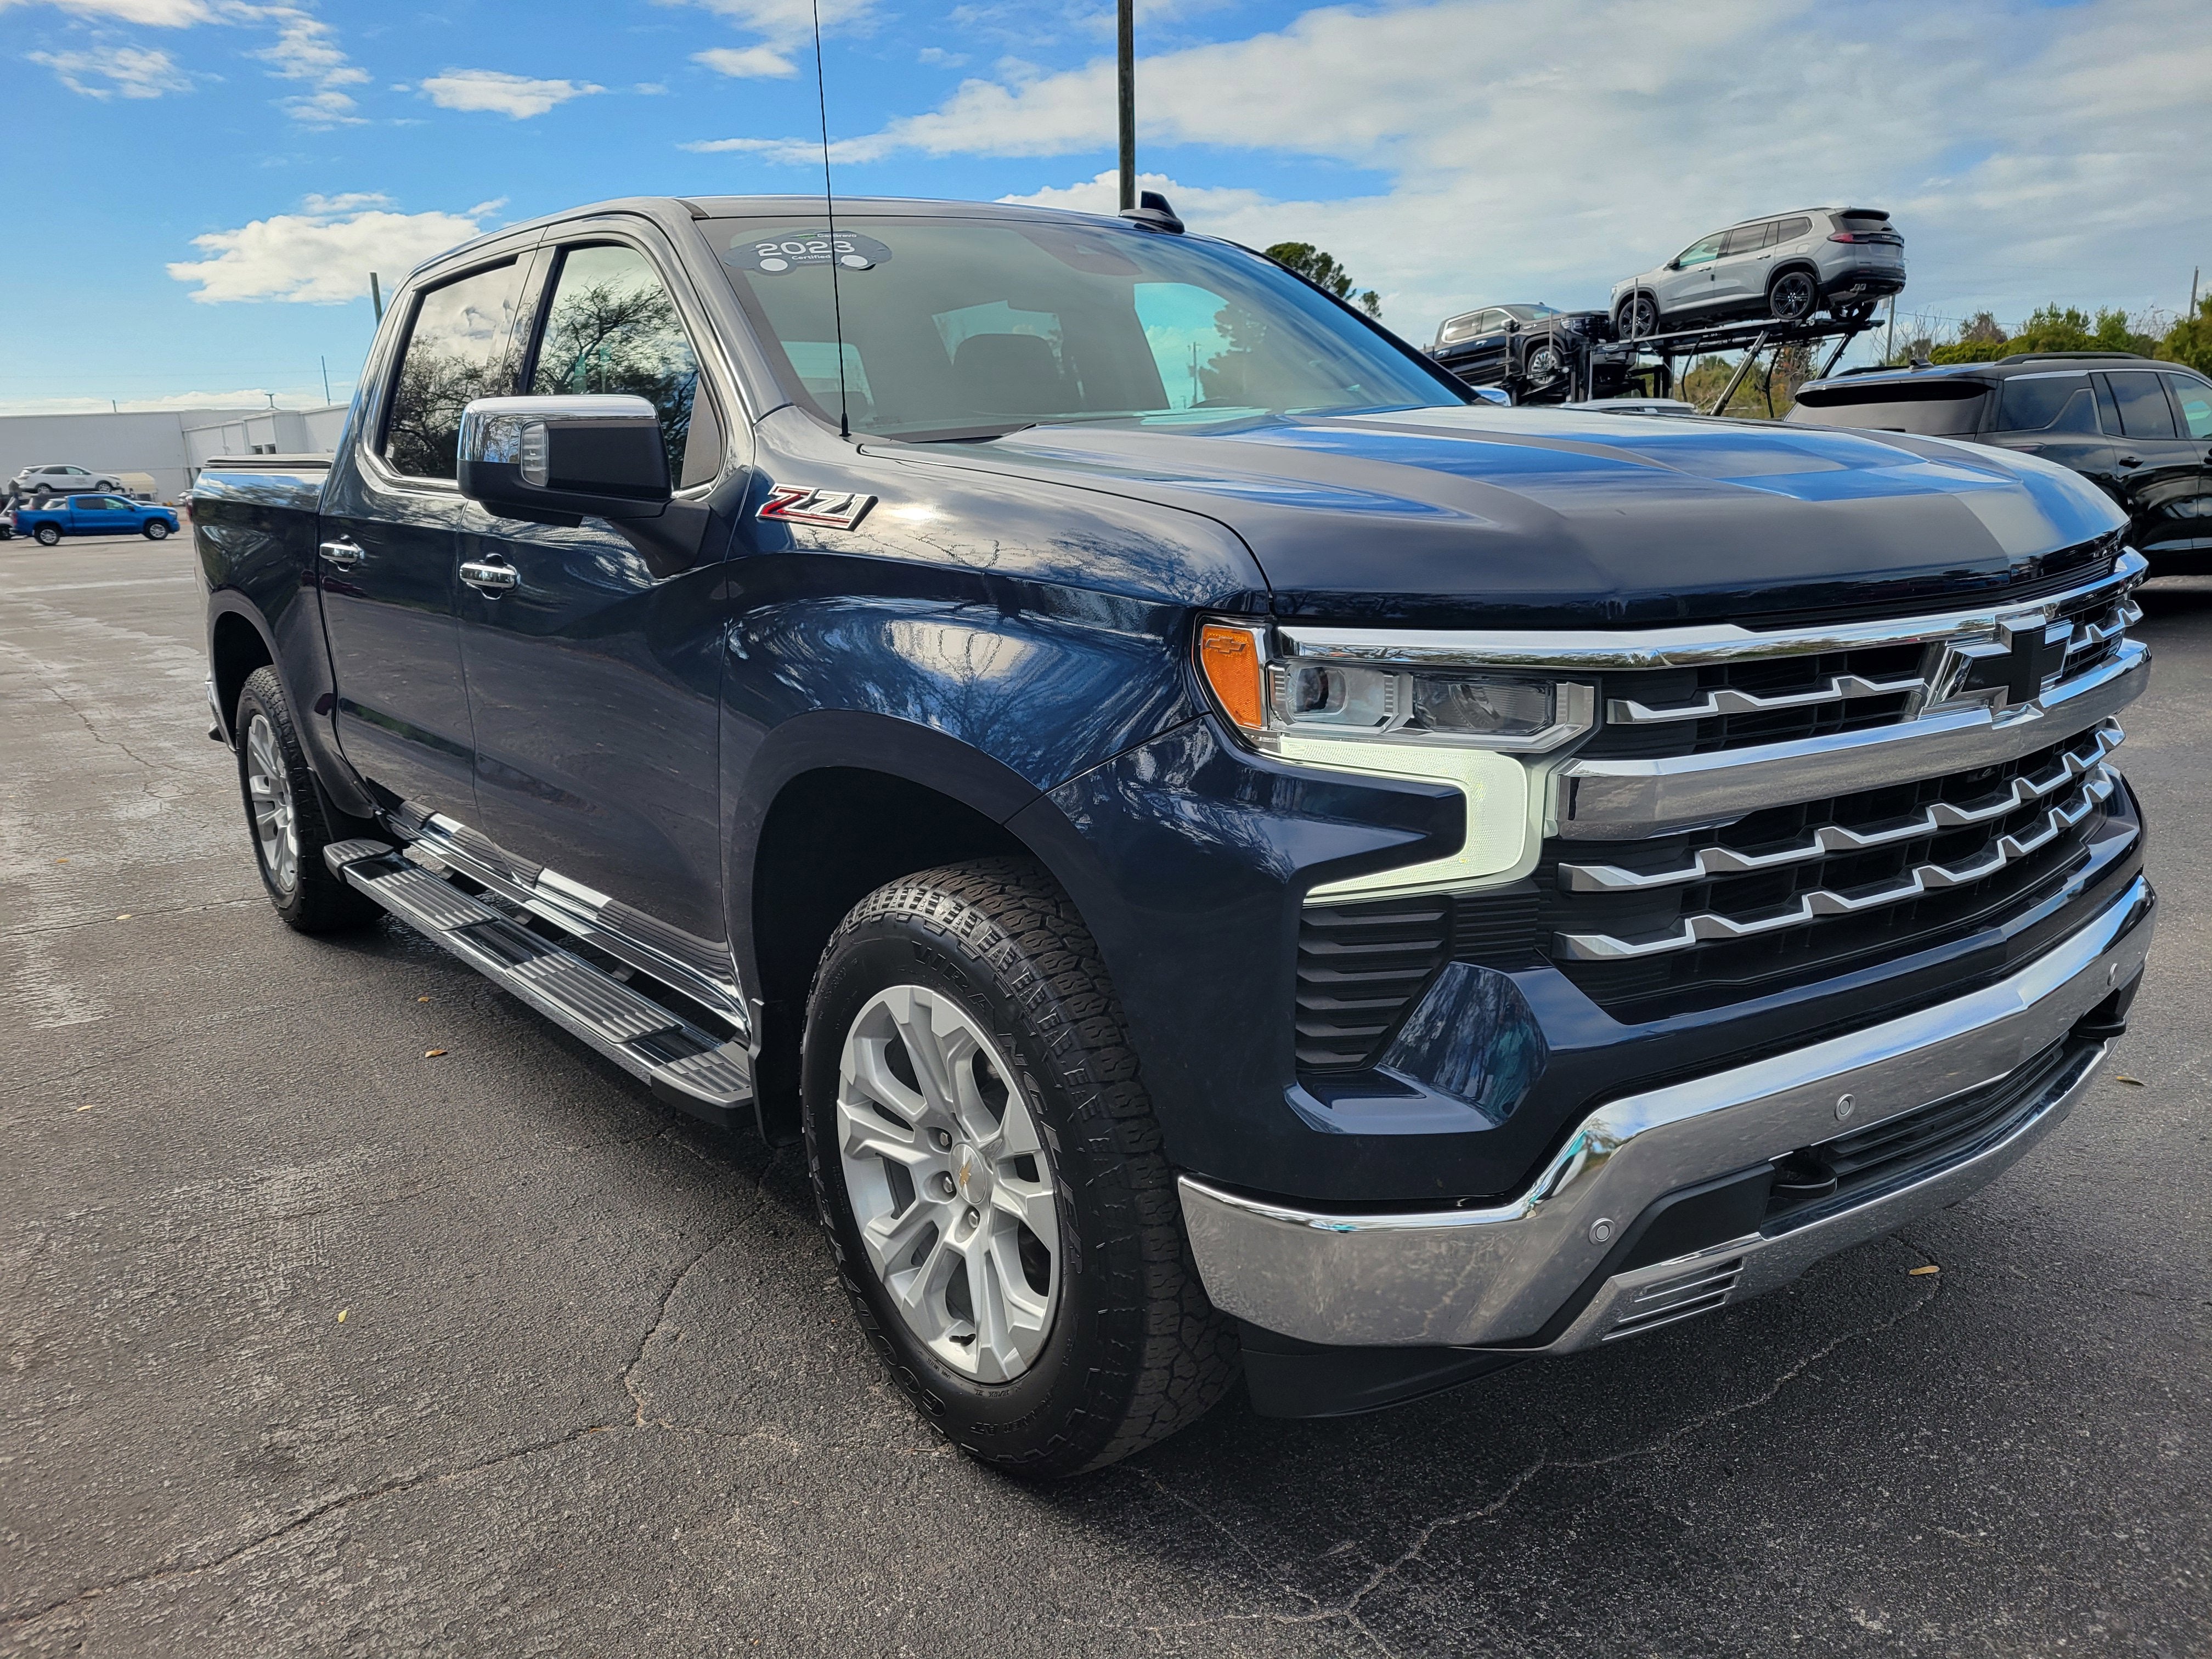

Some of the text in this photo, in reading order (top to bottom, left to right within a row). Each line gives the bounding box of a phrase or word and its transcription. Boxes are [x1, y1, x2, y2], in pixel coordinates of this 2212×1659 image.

[755, 240, 855, 256] 2023
[755, 483, 878, 531] Z71
[911, 940, 1083, 1274] WRANGLER
